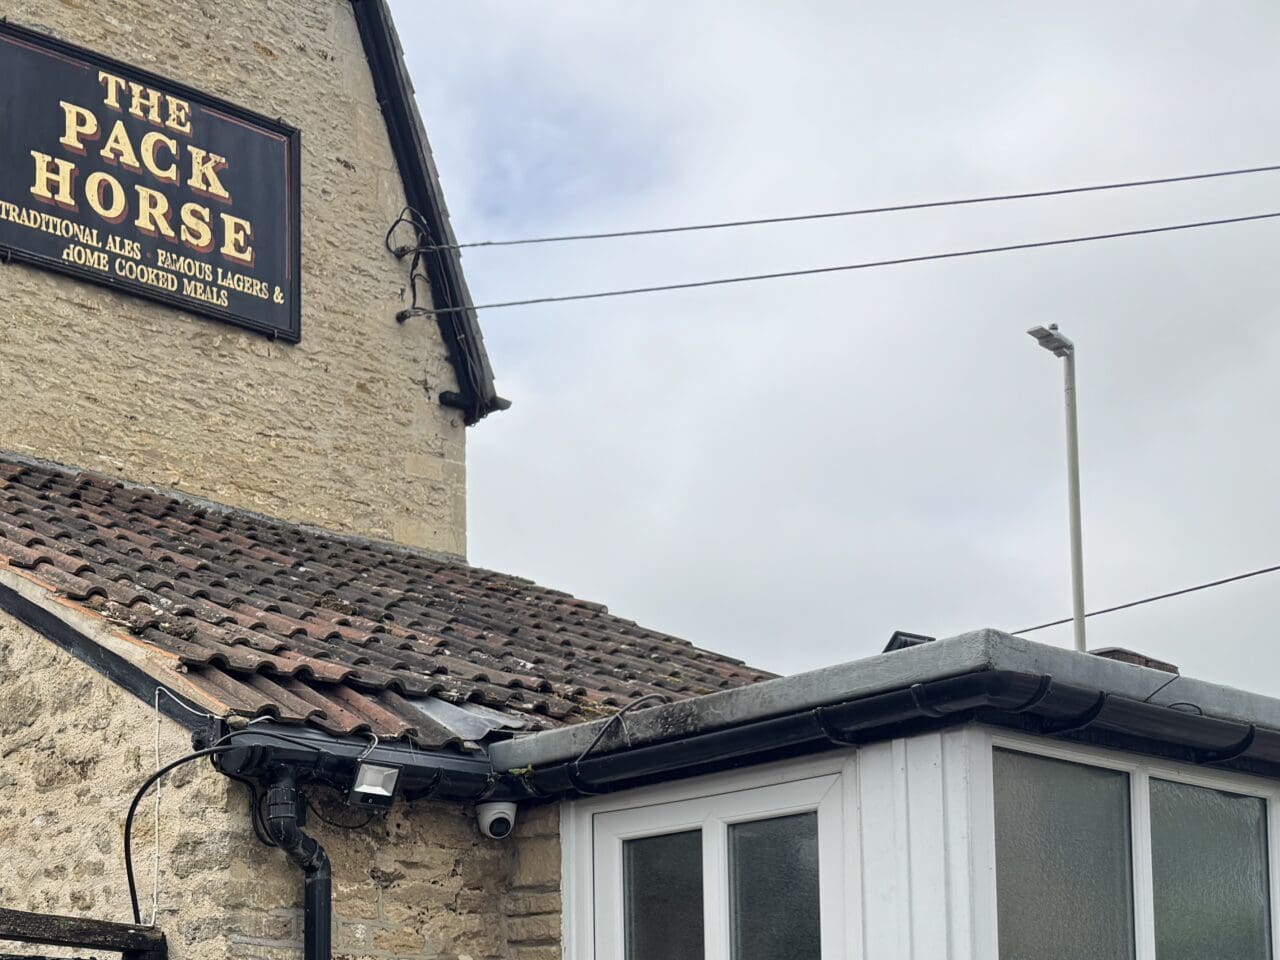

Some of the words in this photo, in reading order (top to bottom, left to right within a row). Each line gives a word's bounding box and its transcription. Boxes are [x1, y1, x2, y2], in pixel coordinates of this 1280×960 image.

[98, 71, 193, 134] THE
[59, 100, 230, 200] PACK
[30, 150, 254, 263] HORSE
[105, 233, 142, 261] ALES
[156, 248, 214, 282] FAMOUS
[217, 267, 270, 300] LAGERS
[273, 285, 285, 305] &
[115, 258, 179, 292] COOKED
[182, 278, 229, 307] MEALS
